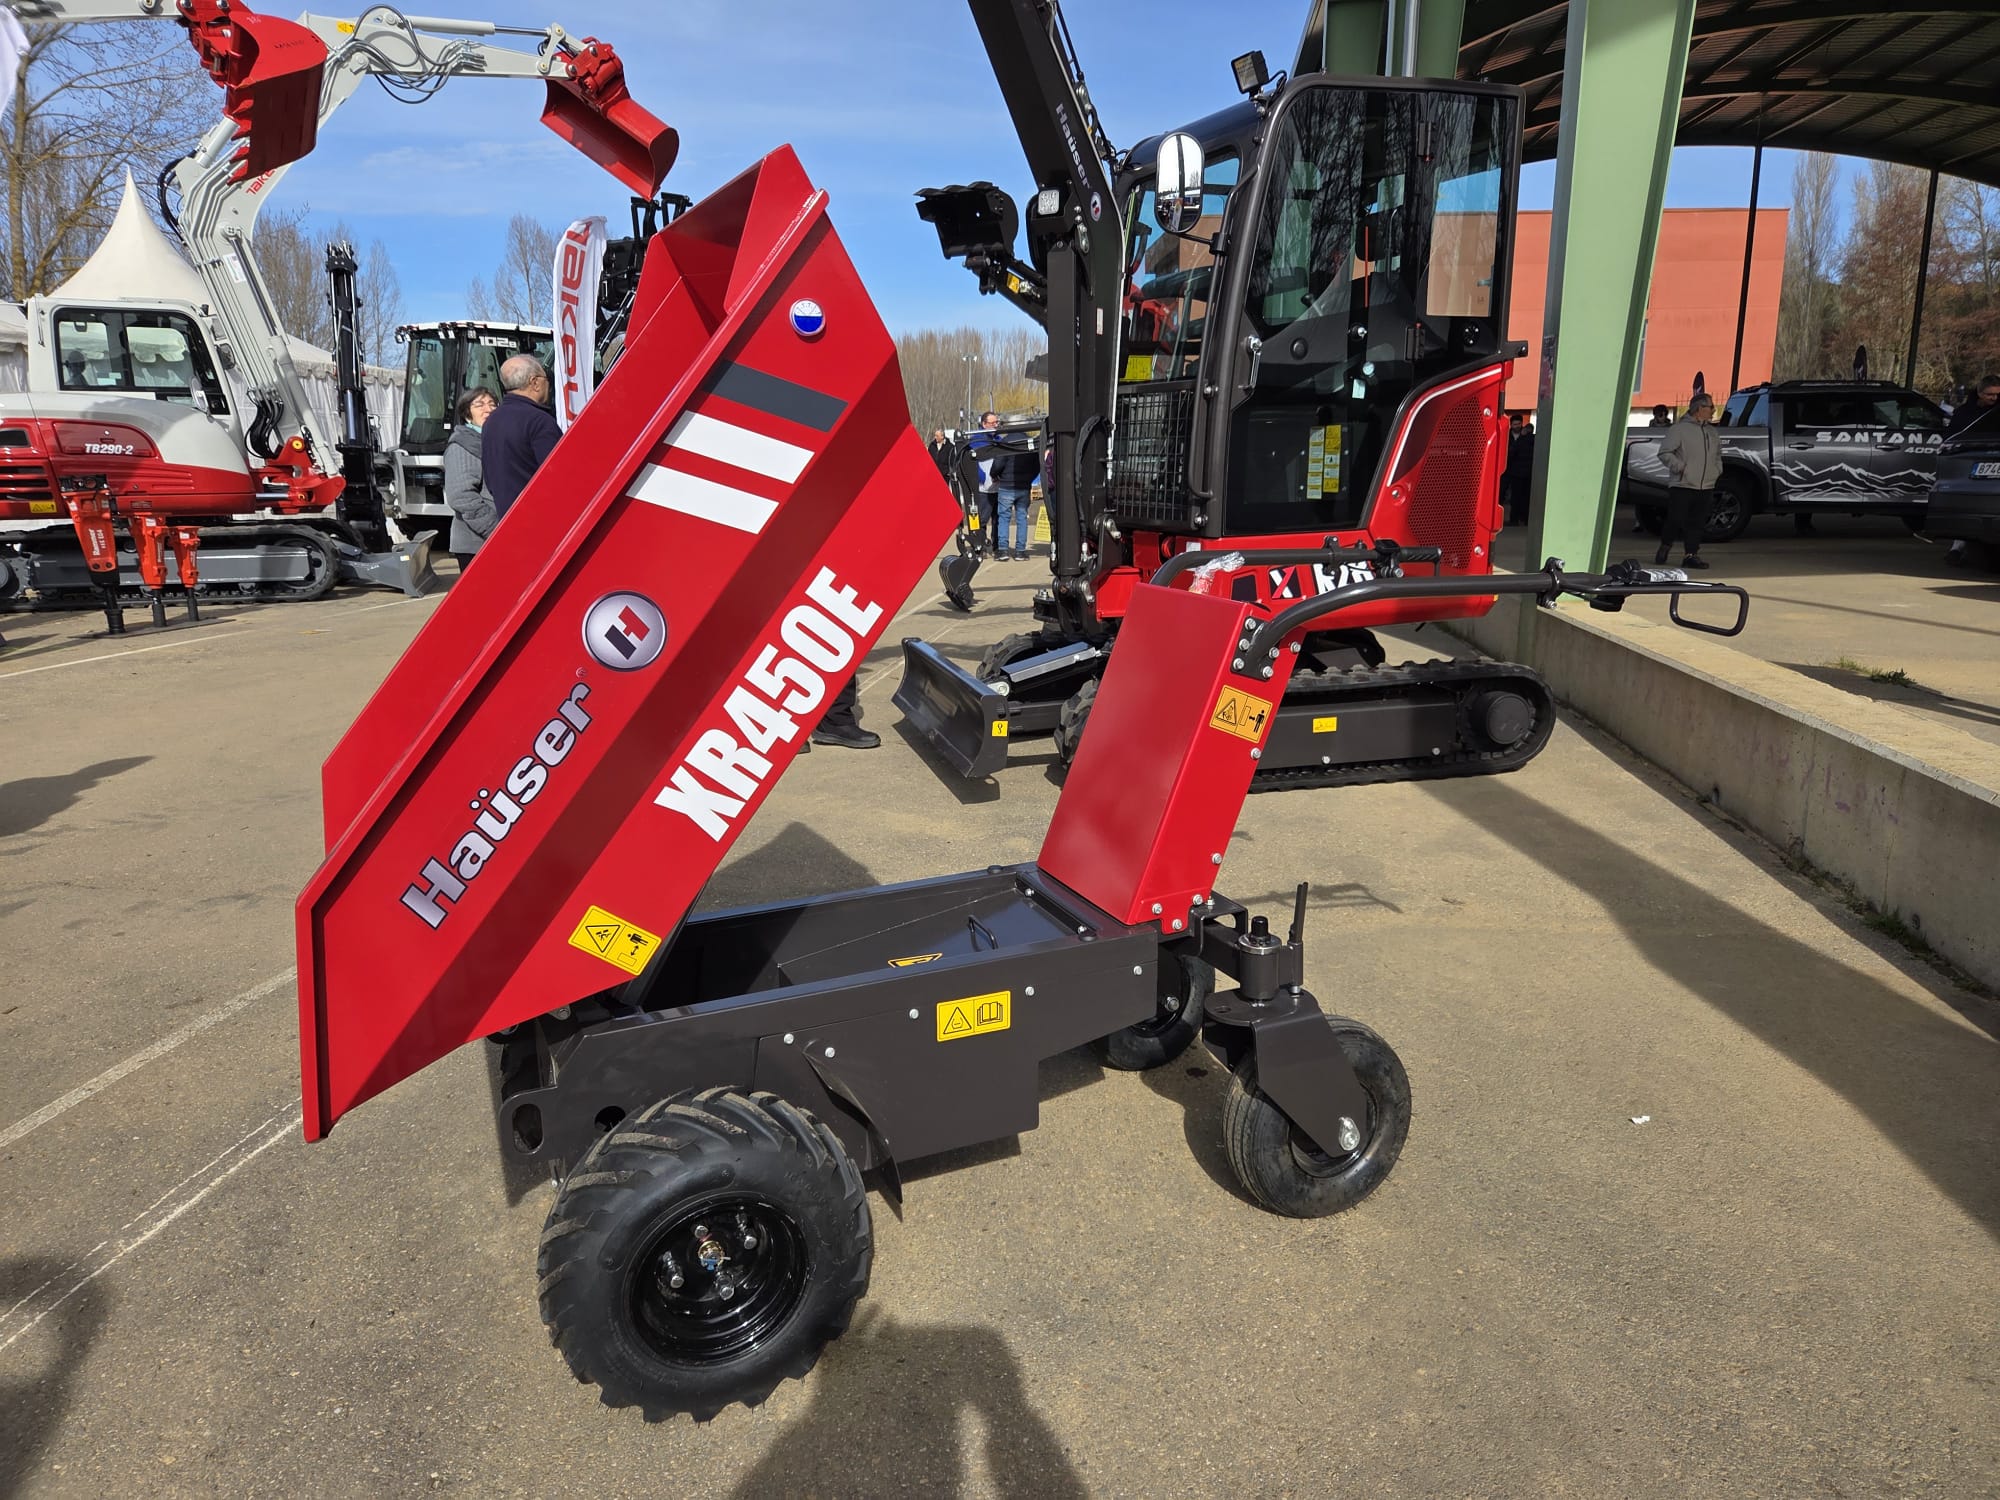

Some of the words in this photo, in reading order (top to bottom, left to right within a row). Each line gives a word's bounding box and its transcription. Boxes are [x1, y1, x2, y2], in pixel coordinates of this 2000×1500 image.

[84, 443, 134, 455] TB290-2
[1816, 432, 1943, 445] SANTANA
[653, 565, 884, 843] XR450E
[401, 682, 594, 931] Haüser
